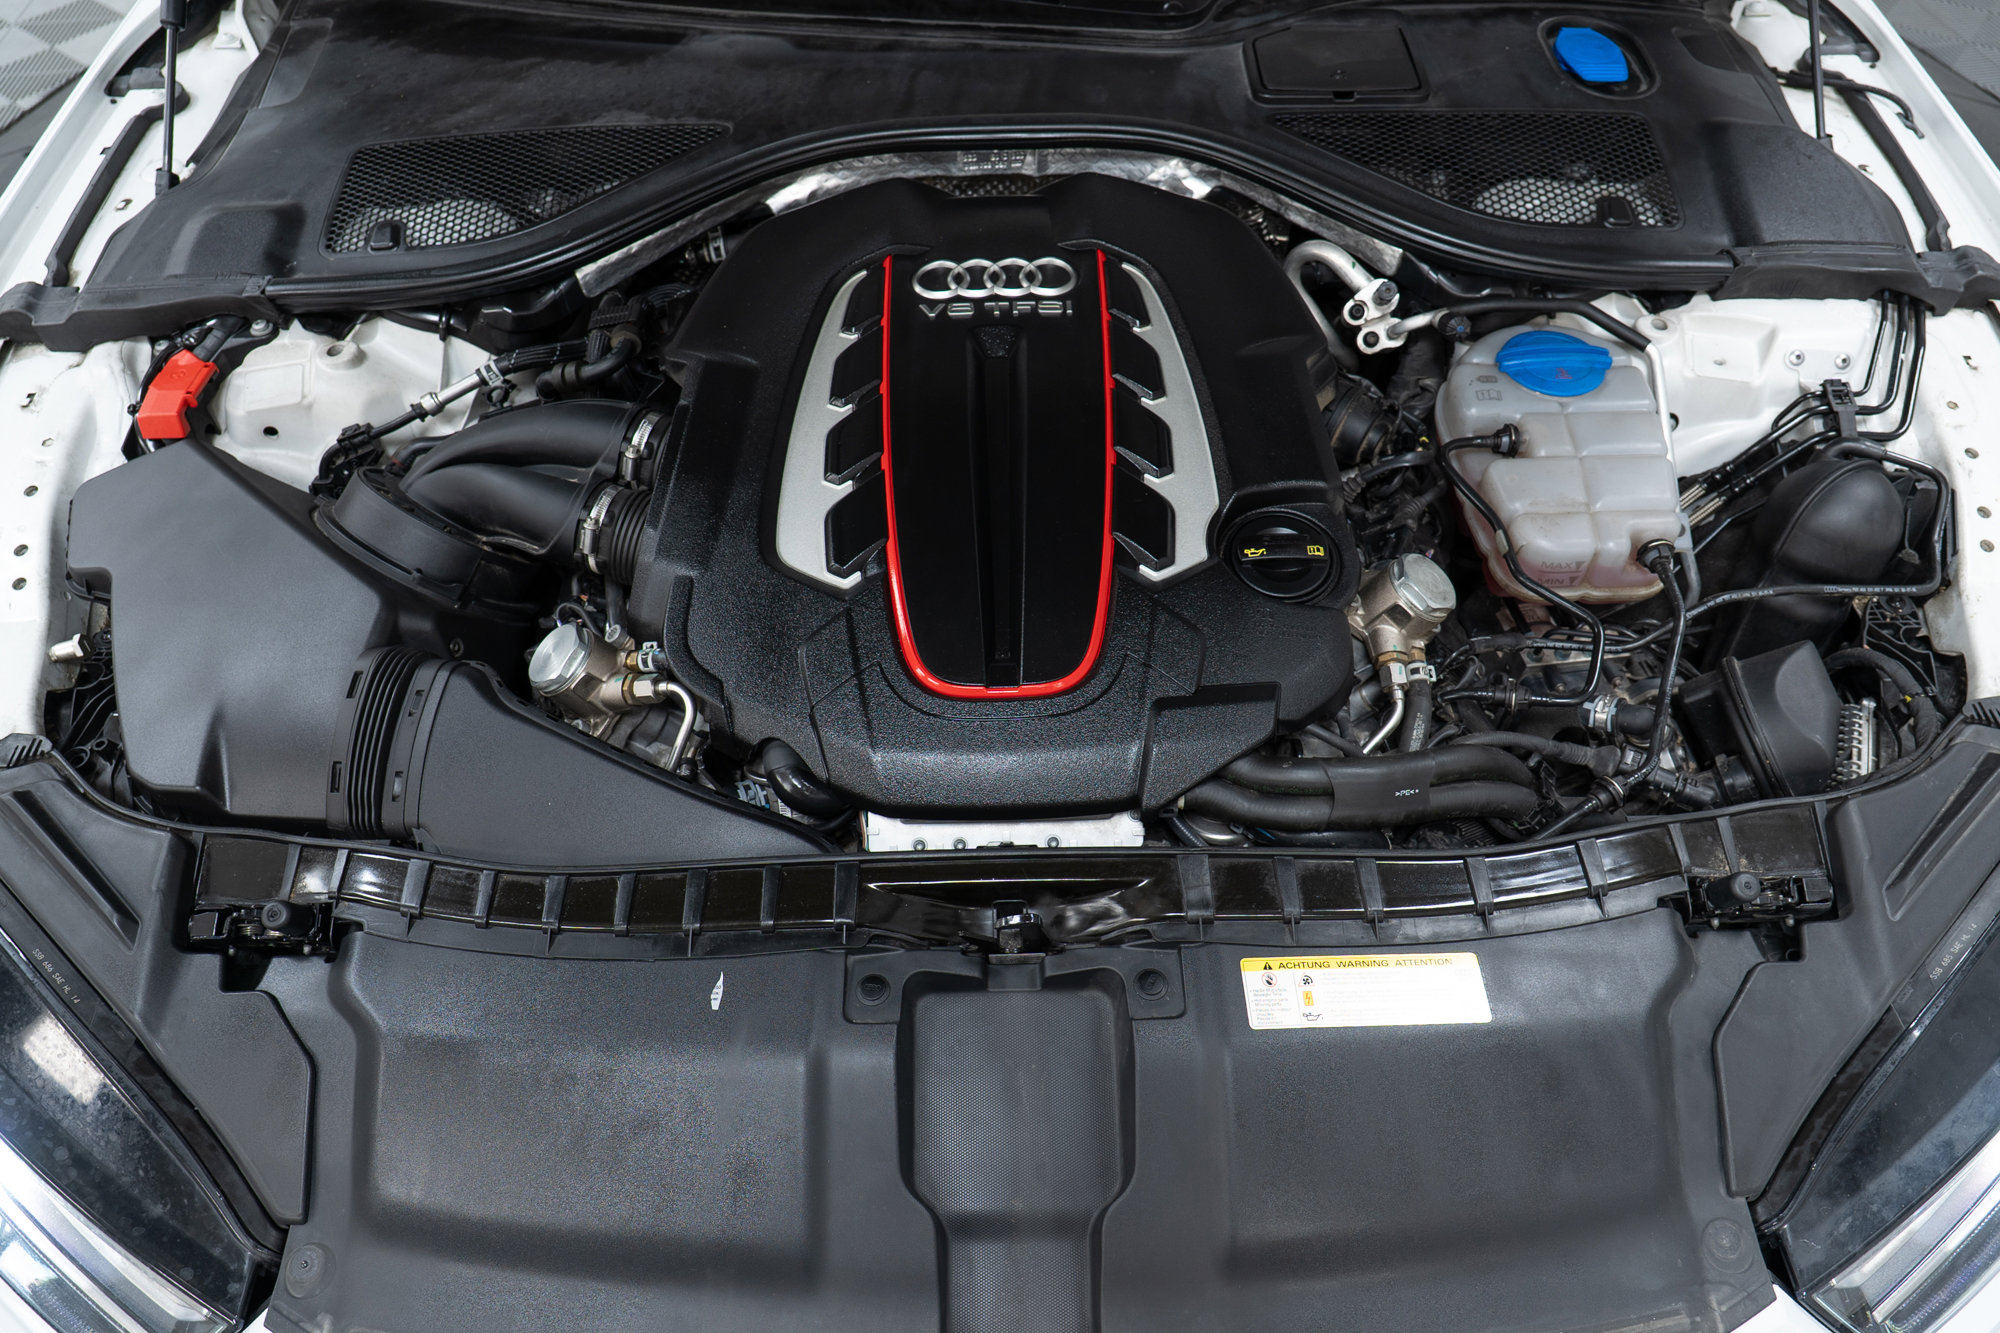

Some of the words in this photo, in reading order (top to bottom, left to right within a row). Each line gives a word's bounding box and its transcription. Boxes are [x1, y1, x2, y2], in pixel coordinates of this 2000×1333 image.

[984, 300, 1073, 318] TFSI
[1540, 561, 1574, 569] MAX
[1951, 941, 1964, 954] SAE
[1278, 960, 1331, 969] ACHTUNG
[1336, 959, 1389, 968] WARNING
[1395, 958, 1453, 967] ATTENTION
[52, 972, 65, 984] SAE
